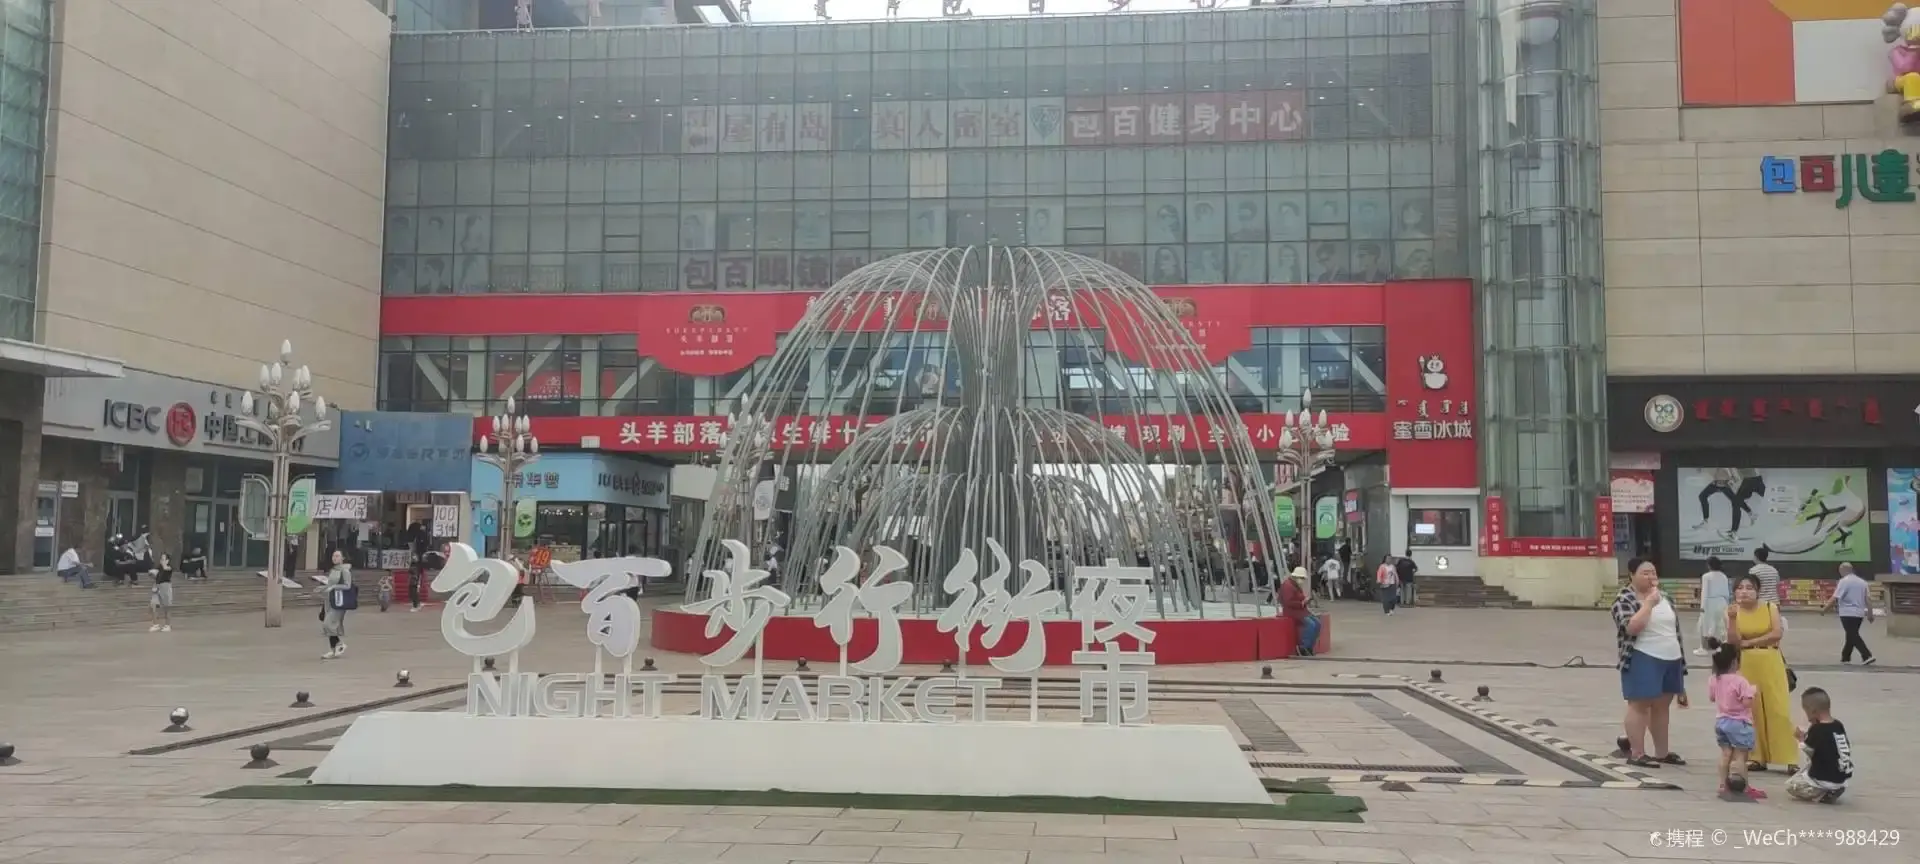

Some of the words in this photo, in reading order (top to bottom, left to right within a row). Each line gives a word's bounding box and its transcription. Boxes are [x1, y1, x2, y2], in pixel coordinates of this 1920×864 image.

[1069, 102, 1302, 138] 包百健身中心
[1760, 149, 1920, 209] 包百儿童
[103, 399, 161, 433] ICBC
[203, 411, 306, 450] 中国工
[1393, 419, 1472, 440] 蜜雪冰城
[431, 538, 1061, 673] 包百步行街
[1071, 558, 1156, 727] 夜市
[466, 672, 677, 719] NIGHT
[700, 674, 1002, 723] MARKET
